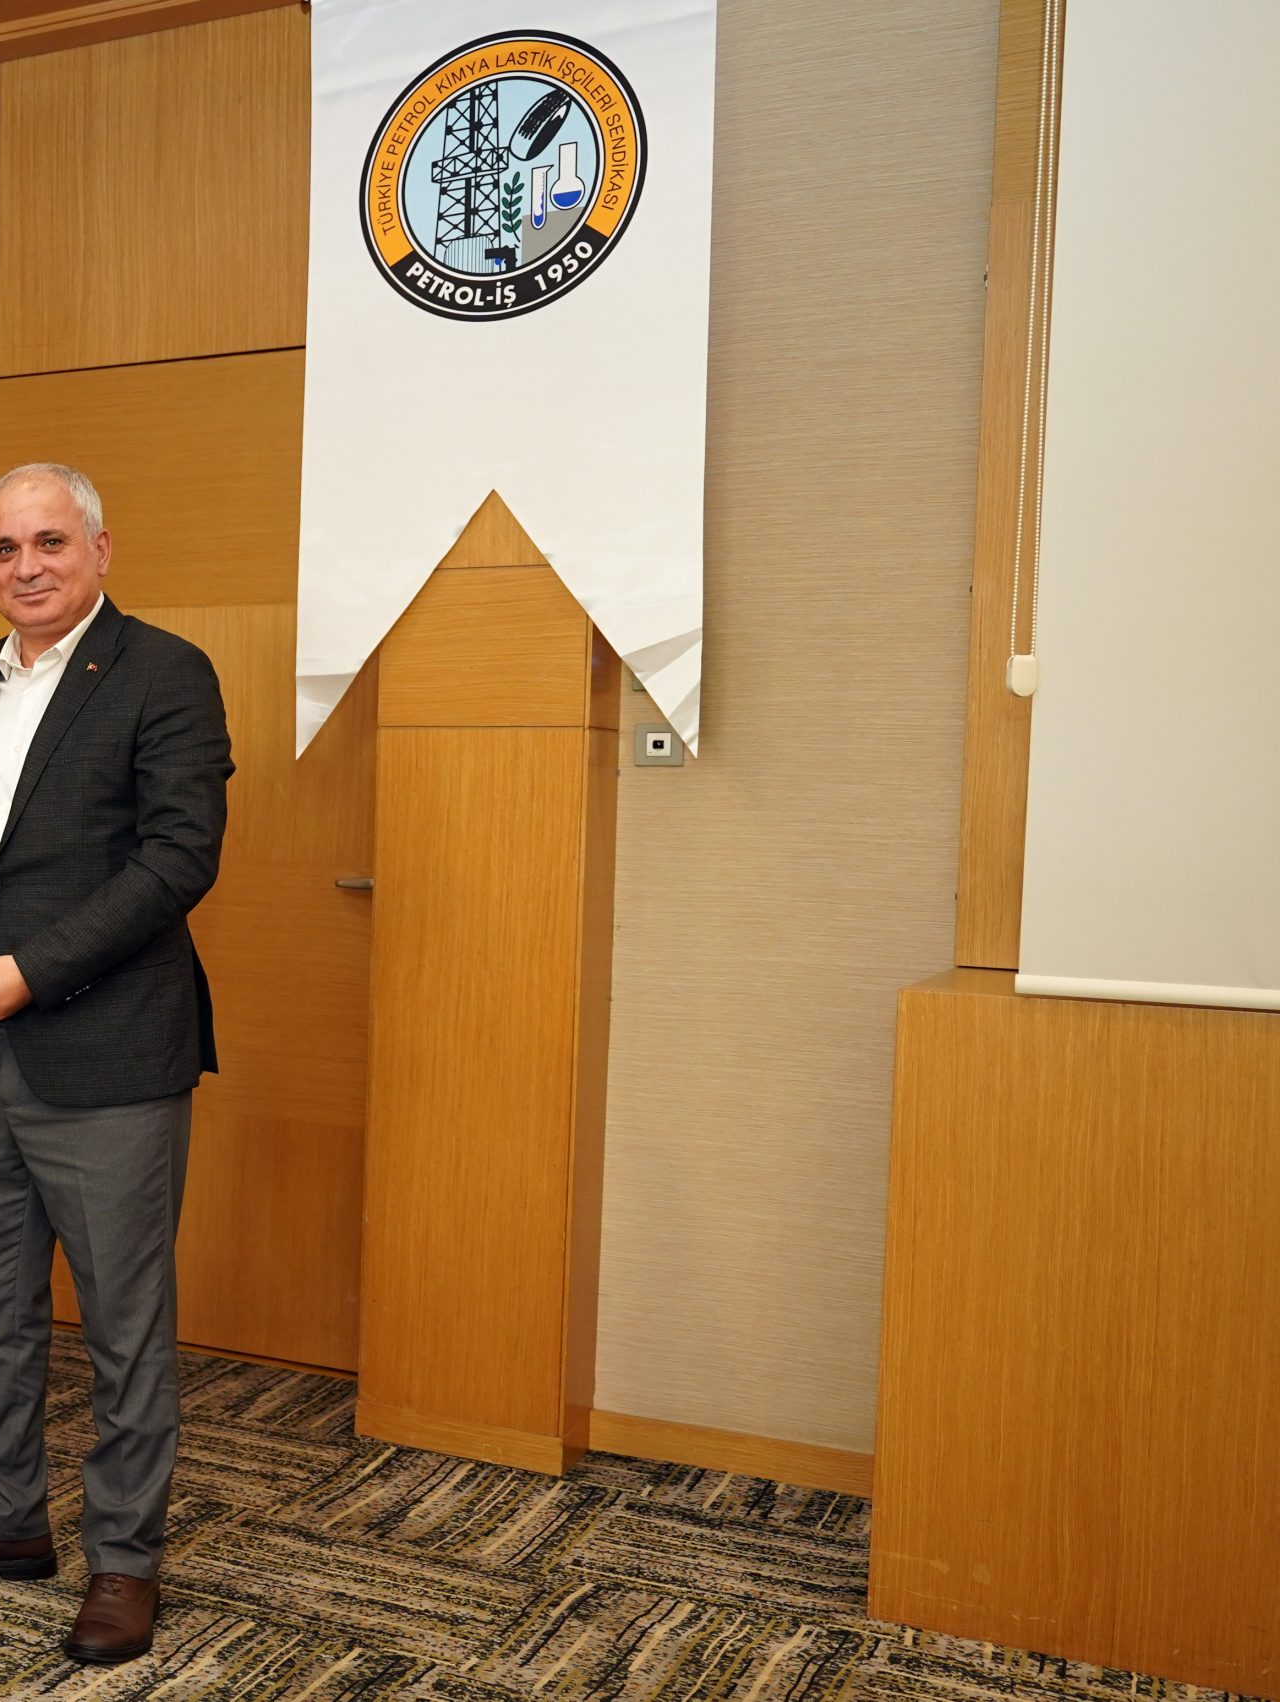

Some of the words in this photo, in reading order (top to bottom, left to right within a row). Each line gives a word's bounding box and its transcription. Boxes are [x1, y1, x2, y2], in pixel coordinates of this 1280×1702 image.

[376, 160, 396, 236] TÜRKİYE
[387, 94, 436, 156] PETROL
[435, 57, 490, 95] KİMYA
[495, 50, 559, 69] LASTİK
[558, 57, 614, 113] İŞÇİLERİ
[601, 113, 628, 211] SENDİKASI
[406, 261, 517, 309] PETROL-İŞ
[534, 241, 593, 292] 1950
